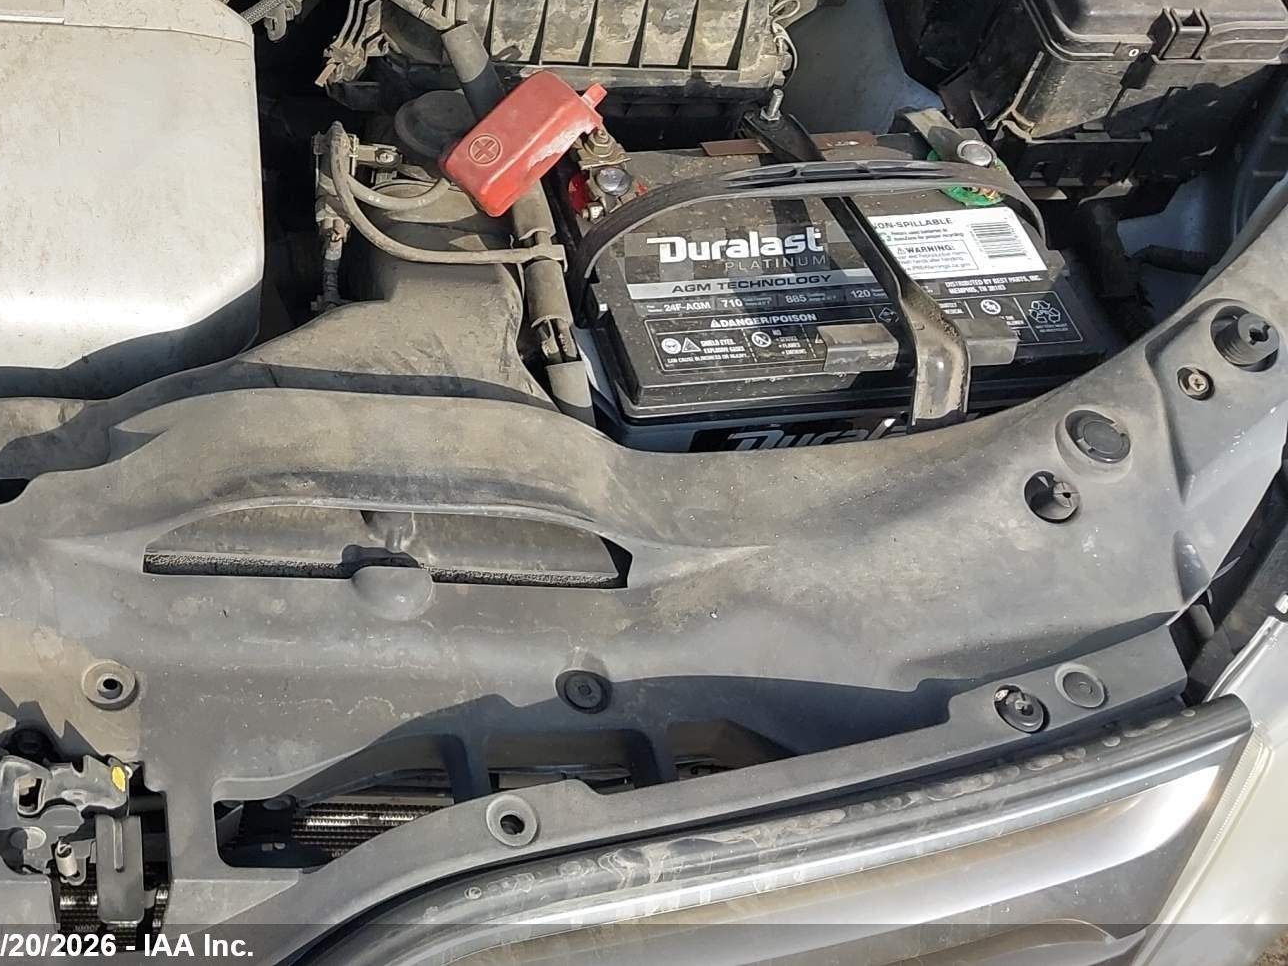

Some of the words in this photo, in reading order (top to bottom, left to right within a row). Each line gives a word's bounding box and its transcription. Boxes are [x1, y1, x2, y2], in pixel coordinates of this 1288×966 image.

[647, 226, 825, 264] Duralast
[906, 244, 956, 254] WARNING:
[724, 255, 827, 273] PLATINUM
[671, 282, 712, 294] AGM
[716, 274, 833, 291] TECHNOLOGY
[785, 294, 808, 304] 885
[850, 289, 871, 299] 120
[663, 301, 712, 313] 24F-AGM
[720, 298, 744, 308] 710
[720, 313, 818, 328] DANGER/POISON
